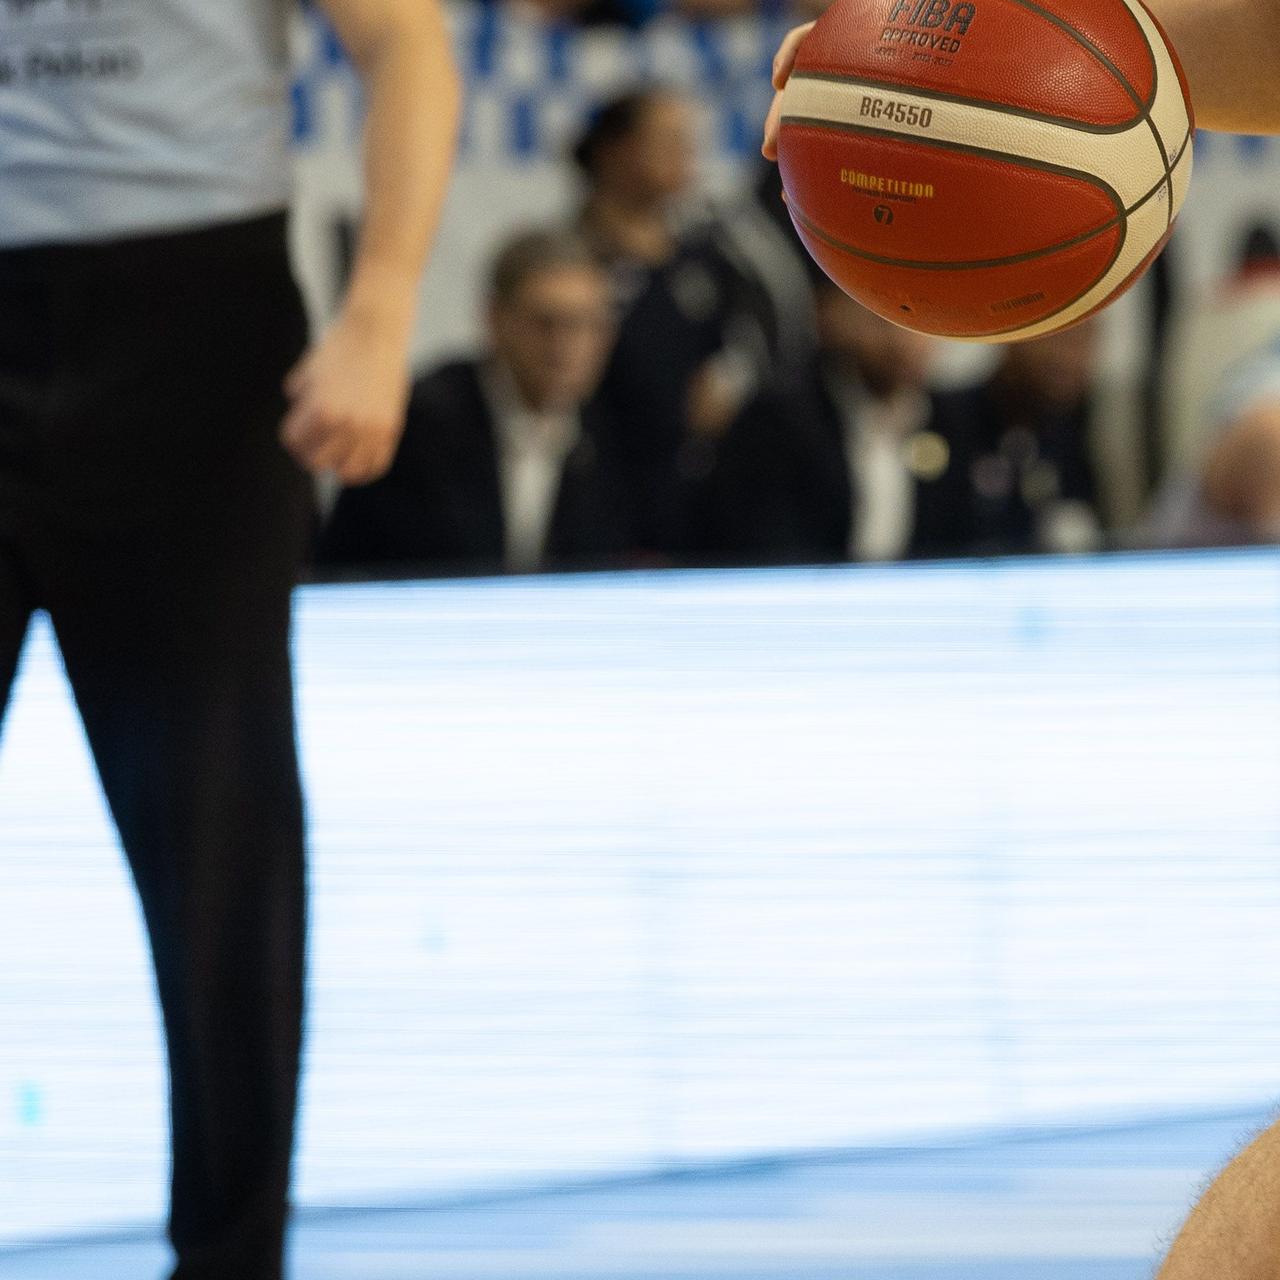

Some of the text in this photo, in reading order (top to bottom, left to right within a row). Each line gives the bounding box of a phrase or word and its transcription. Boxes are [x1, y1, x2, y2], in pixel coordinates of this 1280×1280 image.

[880, 26, 961, 54] APPROVED
[860, 96, 933, 129] BG4550
[840, 168, 934, 198] COMPETITION
